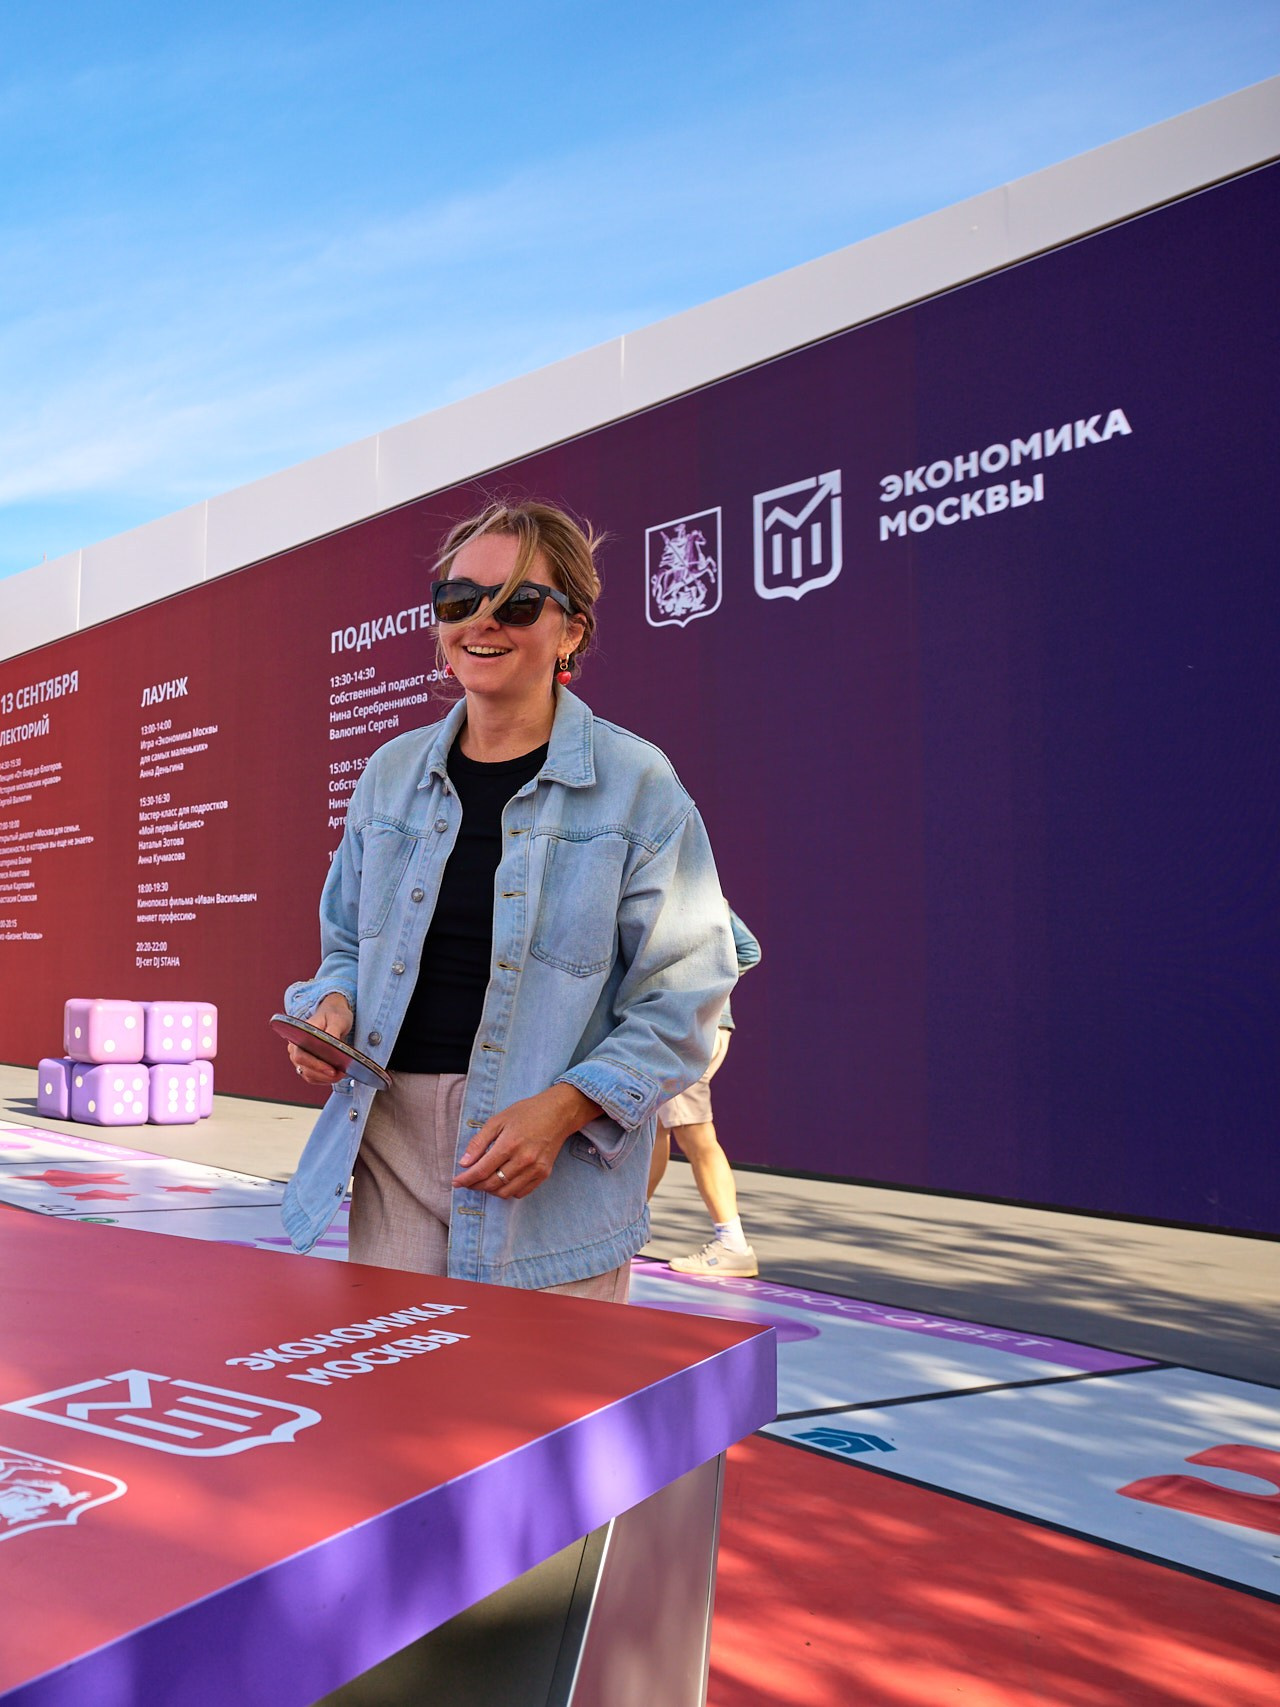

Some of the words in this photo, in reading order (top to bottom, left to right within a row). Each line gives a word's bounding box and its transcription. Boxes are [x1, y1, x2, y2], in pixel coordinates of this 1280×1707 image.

[878, 408, 1133, 502] ЭКОНОМИКА
[879, 473, 1045, 542] МОСКВЫ
[330, 666, 376, 688] 13:30-14:30
[0, 692, 14, 715] 13
[16, 670, 79, 710] СЕНТЯБРЯ
[141, 676, 188, 708] ЛАУНЖ
[329, 681, 386, 705] Собственный
[388, 674, 424, 691] подкаст
[329, 710, 351, 723] Нина
[353, 692, 428, 718] Серебренникова
[140, 740, 155, 750] Игра
[155, 731, 192, 746] «Экономика
[192, 725, 218, 738] Москвы
[141, 719, 172, 736] 13:00-14:00
[329, 723, 366, 740] Валюгин
[368, 715, 399, 733] Сергей
[140, 756, 150, 766] для
[151, 751, 170, 762] самых
[170, 743, 209, 757] маленьких»
[140, 769, 154, 779] Анна
[154, 762, 184, 778] Деньгина
[329, 757, 369, 775] 15:00-15:3
[329, 779, 357, 792] Собств
[139, 808, 178, 821] Мастер-класс
[178, 806, 190, 817] для
[190, 800, 229, 815] подростков
[140, 793, 171, 807] 15:30-16:30
[138, 824, 154, 835] «Мой
[155, 821, 178, 835] первый
[179, 819, 205, 831] бизнес»
[138, 840, 162, 850] Наталья
[162, 837, 184, 848] Зотова
[138, 855, 152, 865] Анна
[137, 882, 169, 893] 18:00-19:30
[137, 898, 168, 908] Кинопоказ
[169, 896, 194, 909] фильма
[194, 895, 215, 905] «Иван
[215, 893, 257, 904] Васильевич
[136, 913, 158, 923] меняет
[158, 911, 197, 924] профессию»
[136, 941, 168, 952] 20:20-22:00
[153, 956, 160, 969] DJ
[691, 1275, 1053, 1348] ВОПРОС-ОТВЕТ
[225, 1302, 468, 1371] ЭКОНОМИКА
[285, 1329, 471, 1386] МОСКВЫ
